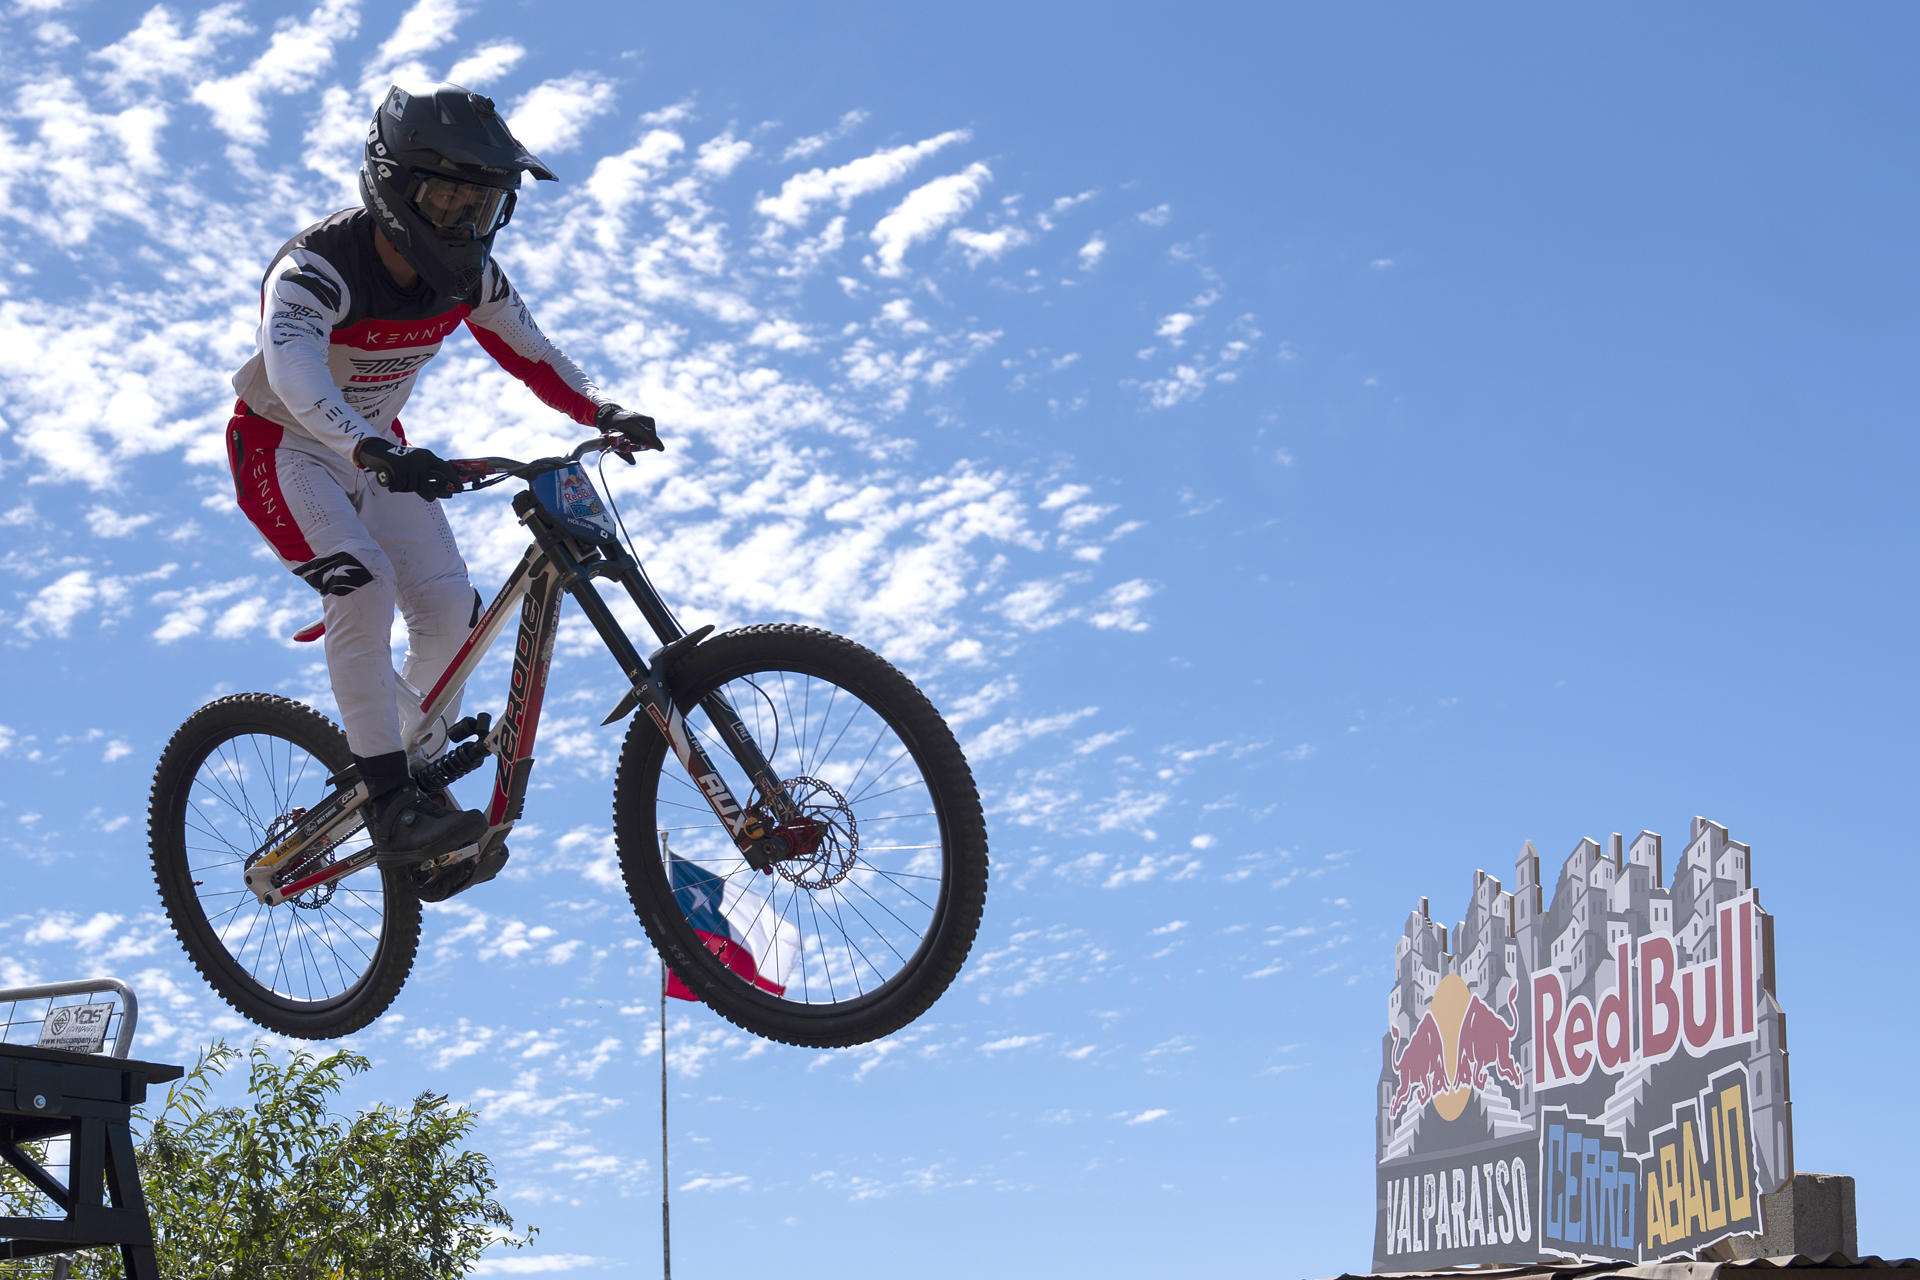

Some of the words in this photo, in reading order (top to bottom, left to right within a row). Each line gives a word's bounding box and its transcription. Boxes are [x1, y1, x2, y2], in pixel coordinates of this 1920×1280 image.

[366, 320, 449, 344] KENNY
[251, 448, 286, 527] KENNY
[698, 772, 749, 835] RUX
[1386, 1156, 1532, 1255] VALPARAISO
[1546, 1124, 1637, 1250] CERRO
[1646, 1084, 1752, 1250] ABAJO
